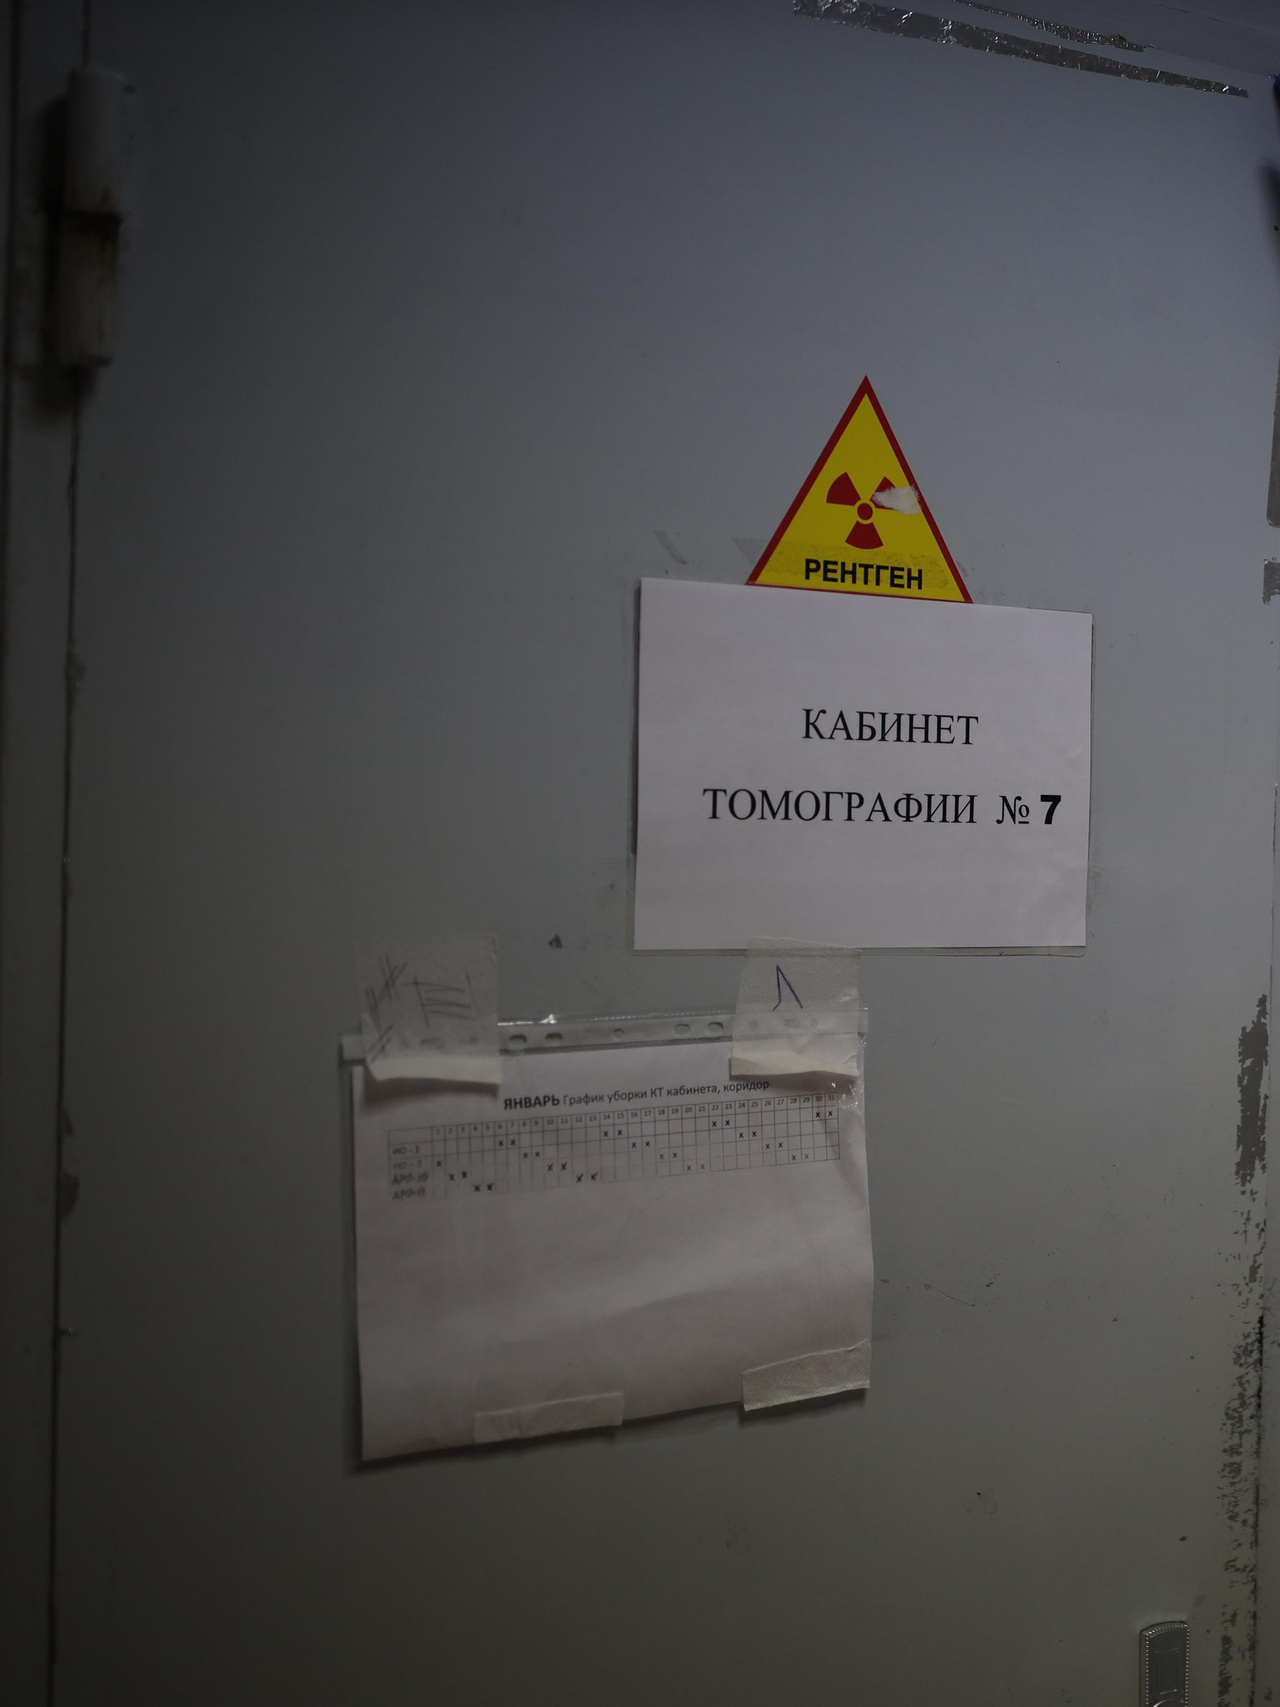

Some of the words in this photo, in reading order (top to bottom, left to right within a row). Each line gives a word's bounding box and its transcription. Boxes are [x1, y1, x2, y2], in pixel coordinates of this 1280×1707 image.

[804, 557, 923, 590] РЕНТГЕН
[801, 707, 980, 745] КАБИНЕТ
[702, 788, 978, 824] ТОМОГРАФИИ
[996, 795, 1030, 825] №
[1040, 794, 1062, 825] 7
[503, 1094, 560, 1110] ЯНВАРЬ
[563, 1093, 605, 1107] График
[607, 1090, 648, 1103] уборки
[650, 1087, 664, 1098] КТ
[666, 1085, 720, 1097] кабинета,
[723, 1080, 770, 1093] коридор
